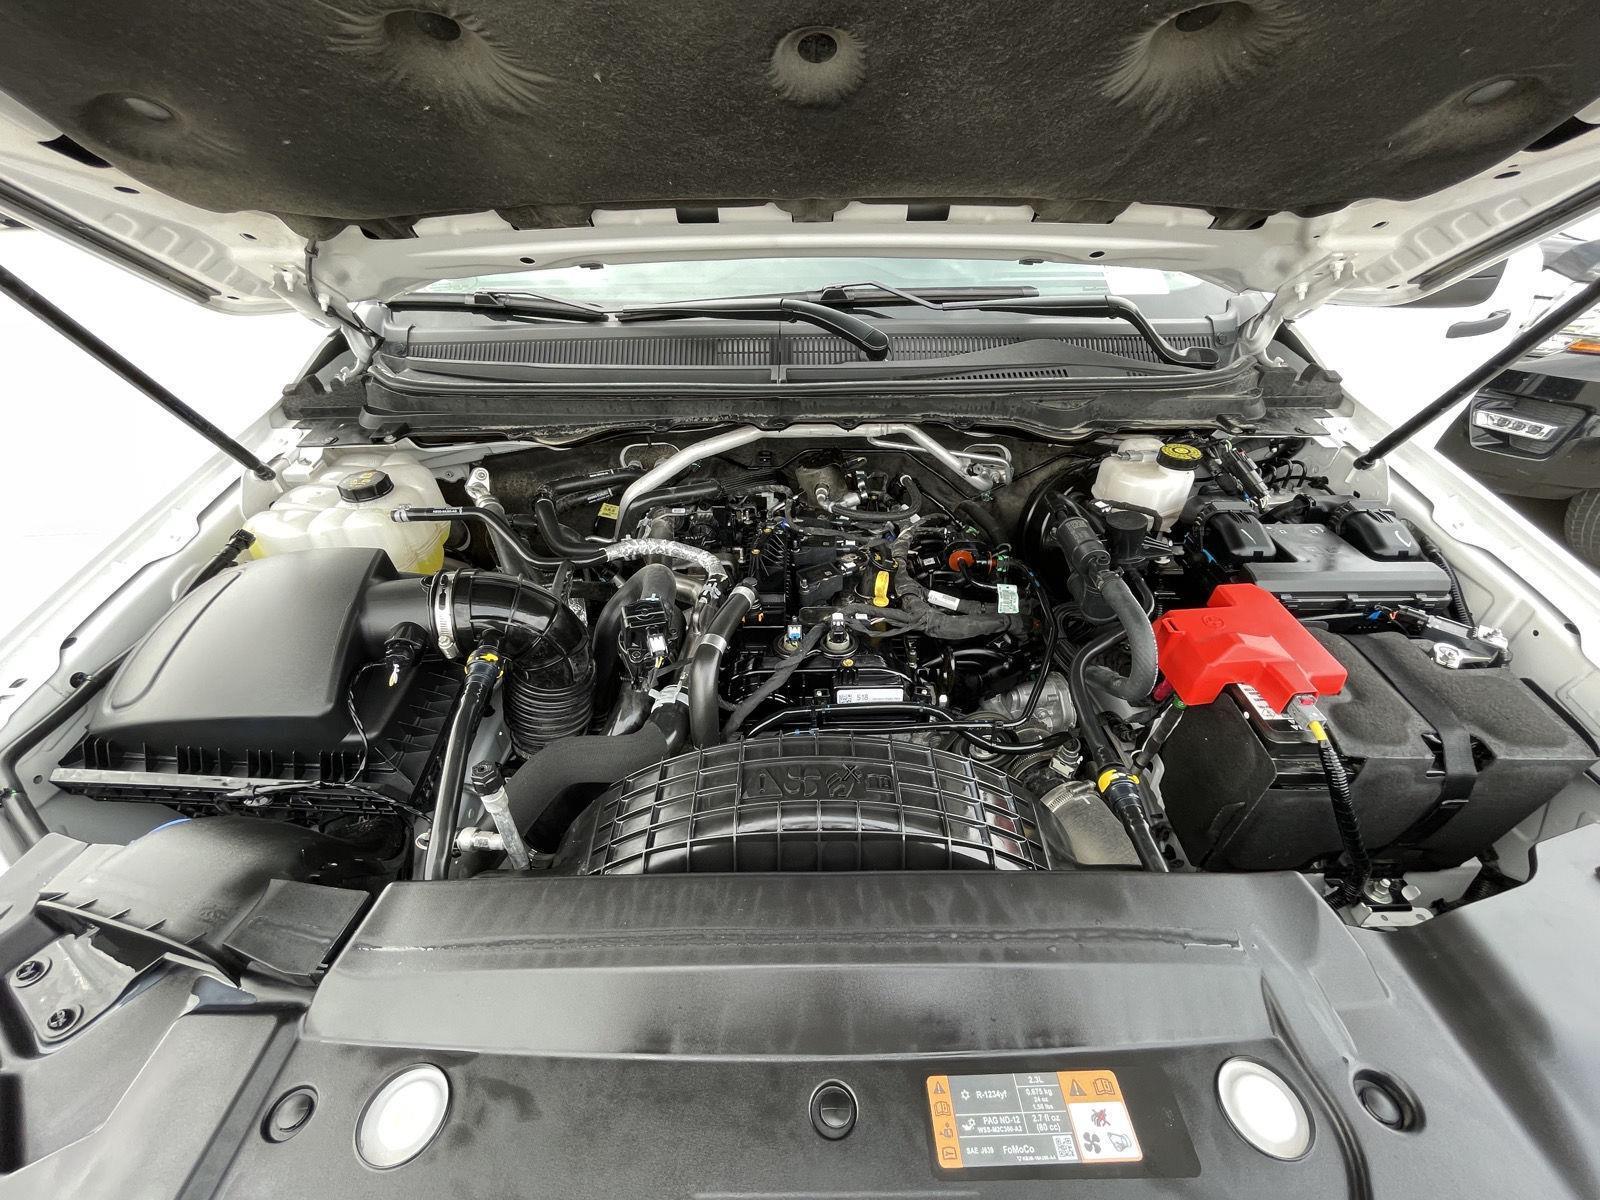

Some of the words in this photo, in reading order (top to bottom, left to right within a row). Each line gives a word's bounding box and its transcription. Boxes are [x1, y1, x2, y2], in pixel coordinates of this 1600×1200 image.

[1028, 1075, 1044, 1084] 2.3L
[976, 1089, 1007, 1099] R-1234yf
[983, 1116, 999, 1125] PAG
[1032, 1114, 1042, 1122] 2.7
[1002, 1144, 1035, 1155] FoMoCo
